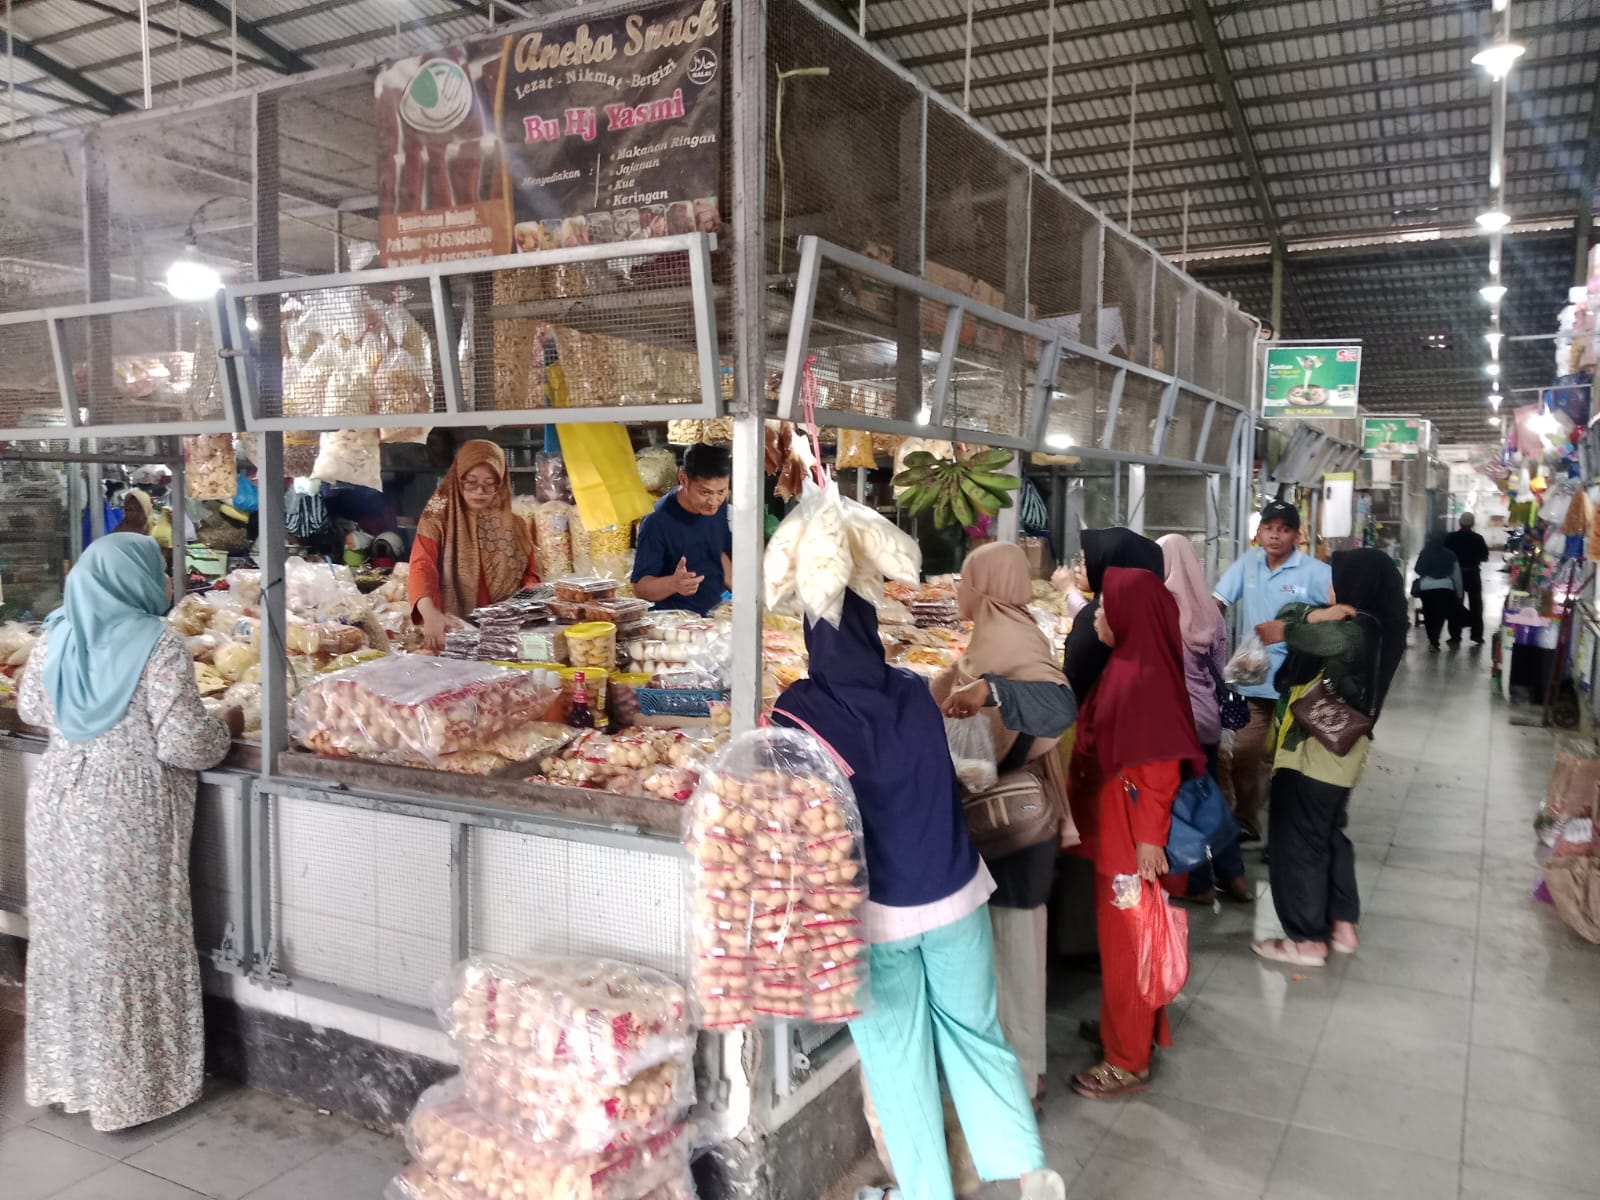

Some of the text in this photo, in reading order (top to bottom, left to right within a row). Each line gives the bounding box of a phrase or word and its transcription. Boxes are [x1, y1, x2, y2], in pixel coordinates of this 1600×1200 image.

[514, 0, 719, 72] Aneka Snack
[515, 76, 553, 100] Lezat
[566, 69, 623, 90] Nikmat
[631, 58, 677, 88] Bergizi
[523, 88, 685, 144] Bu Hj Yasmi
[616, 133, 716, 161] Makanan Ringan
[615, 159, 660, 176] Jajanan
[612, 189, 668, 207] Keringan
[613, 178, 635, 190] Kue
